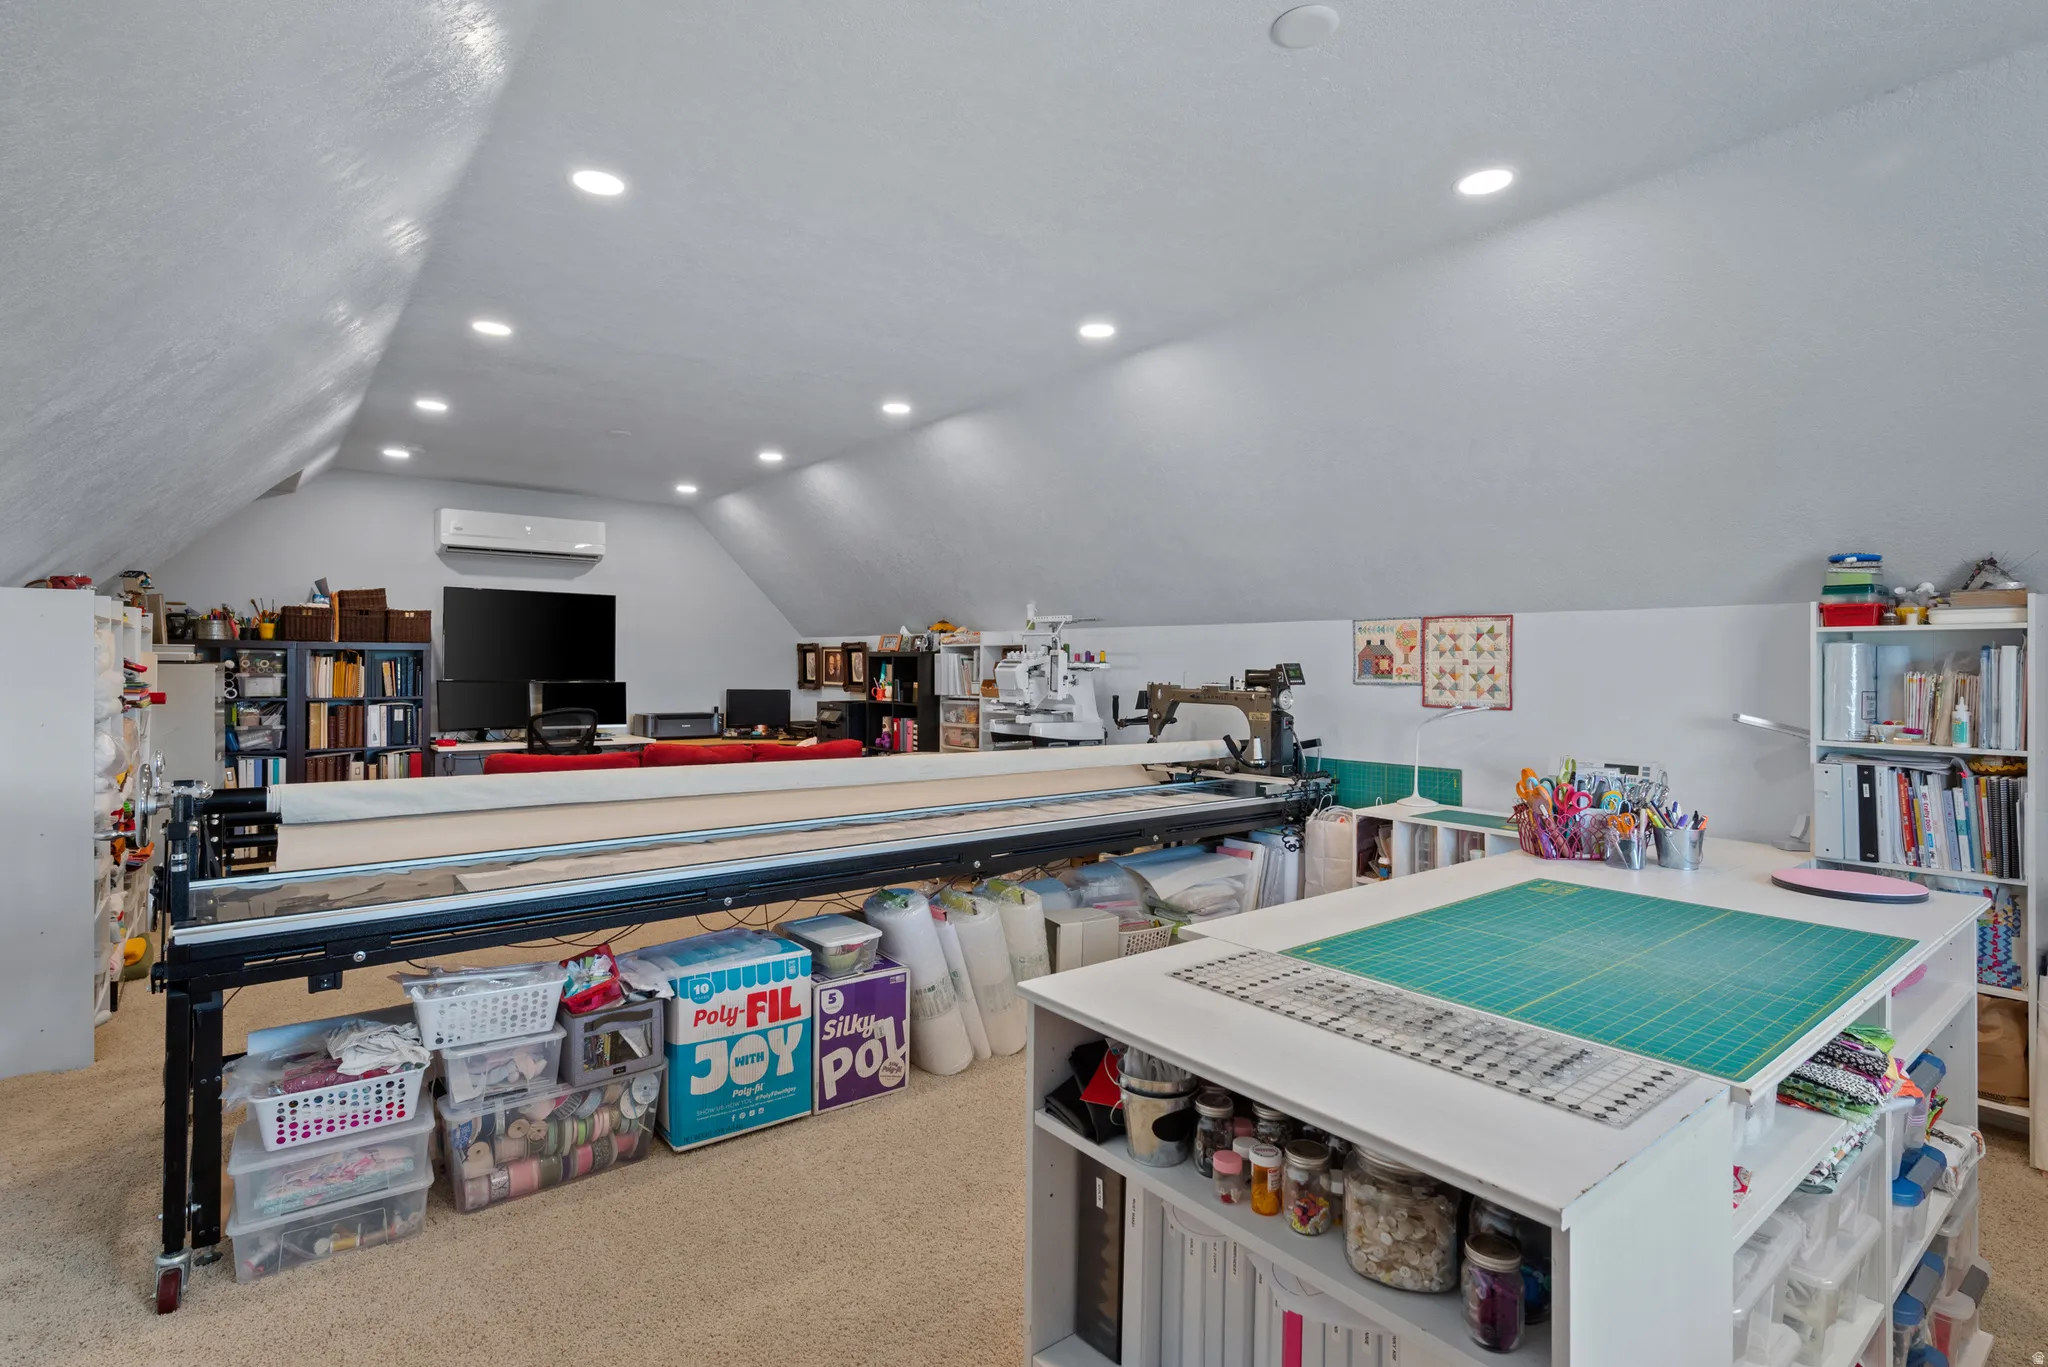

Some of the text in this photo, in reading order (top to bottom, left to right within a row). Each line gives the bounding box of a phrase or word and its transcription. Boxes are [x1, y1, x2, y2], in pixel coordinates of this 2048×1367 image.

[693, 983, 709, 995] 10
[828, 992, 837, 1005] 5
[821, 1013, 876, 1041] Silky
[690, 1023, 803, 1096] JOY
[734, 1051, 765, 1067] WITH
